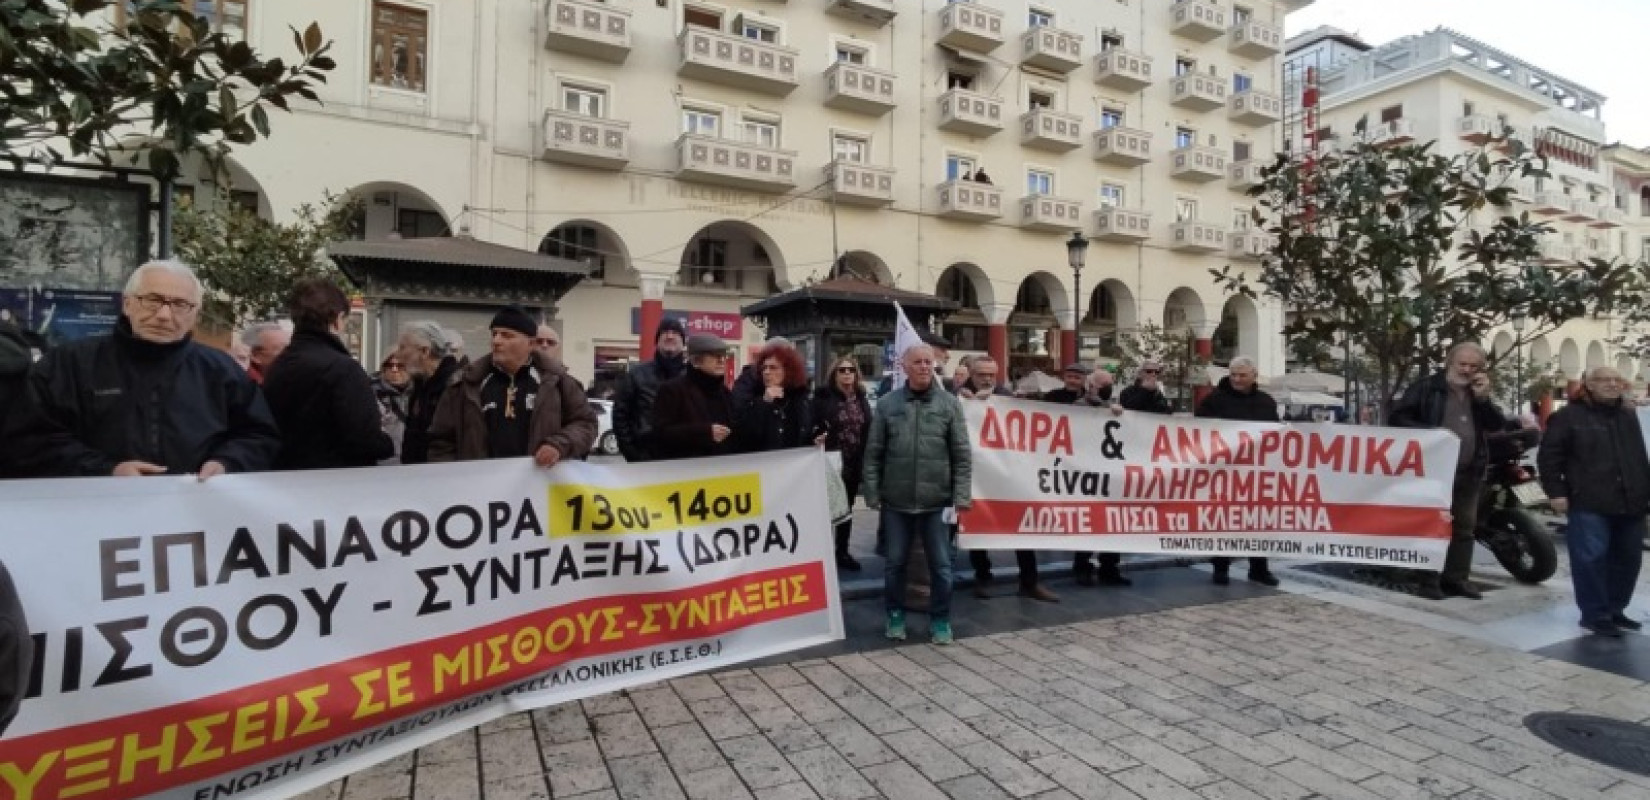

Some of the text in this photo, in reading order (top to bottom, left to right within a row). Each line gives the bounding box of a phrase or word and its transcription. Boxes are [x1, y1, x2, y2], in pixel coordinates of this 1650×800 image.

[979, 407, 1425, 477] ΔΩΡΑ & ΑΝΑΔΡΟΜΙΚΑ
[1037, 457, 1322, 503] είναι ΠΛΗΡΩΜΕΝΑ
[99, 497, 543, 602] ΕΠΑΝΑΦΟΡΑ
[1018, 505, 1332, 533] ΔΩΣΤΕ ΠΙΣΩ τα ΚΛΕΜΜΕΝΑ
[1159, 537, 1214, 551] ΣΩΜΑΤΕΙΟ
[1216, 537, 1302, 553] ΣΥΝΤΑΞΙΟΥΧΩΝ
[1329, 543, 1430, 564] ΣΥΣΠΕΙΡΩΣΗ»
[414, 537, 670, 617] ΣΥΝΤΑΞΗΣ
[676, 513, 800, 573] (ΔΩΡΑ)
[350, 661, 415, 720] ΣΕ
[432, 574, 810, 694] ΜΙΣΘΟΥΣ-ΣΥΝΤΑΞΕΙΣ
[193, 756, 304, 800] ΕΝΩΣΗ
[650, 640, 723, 670] (Ε.Σ.Ε.Θ.)
